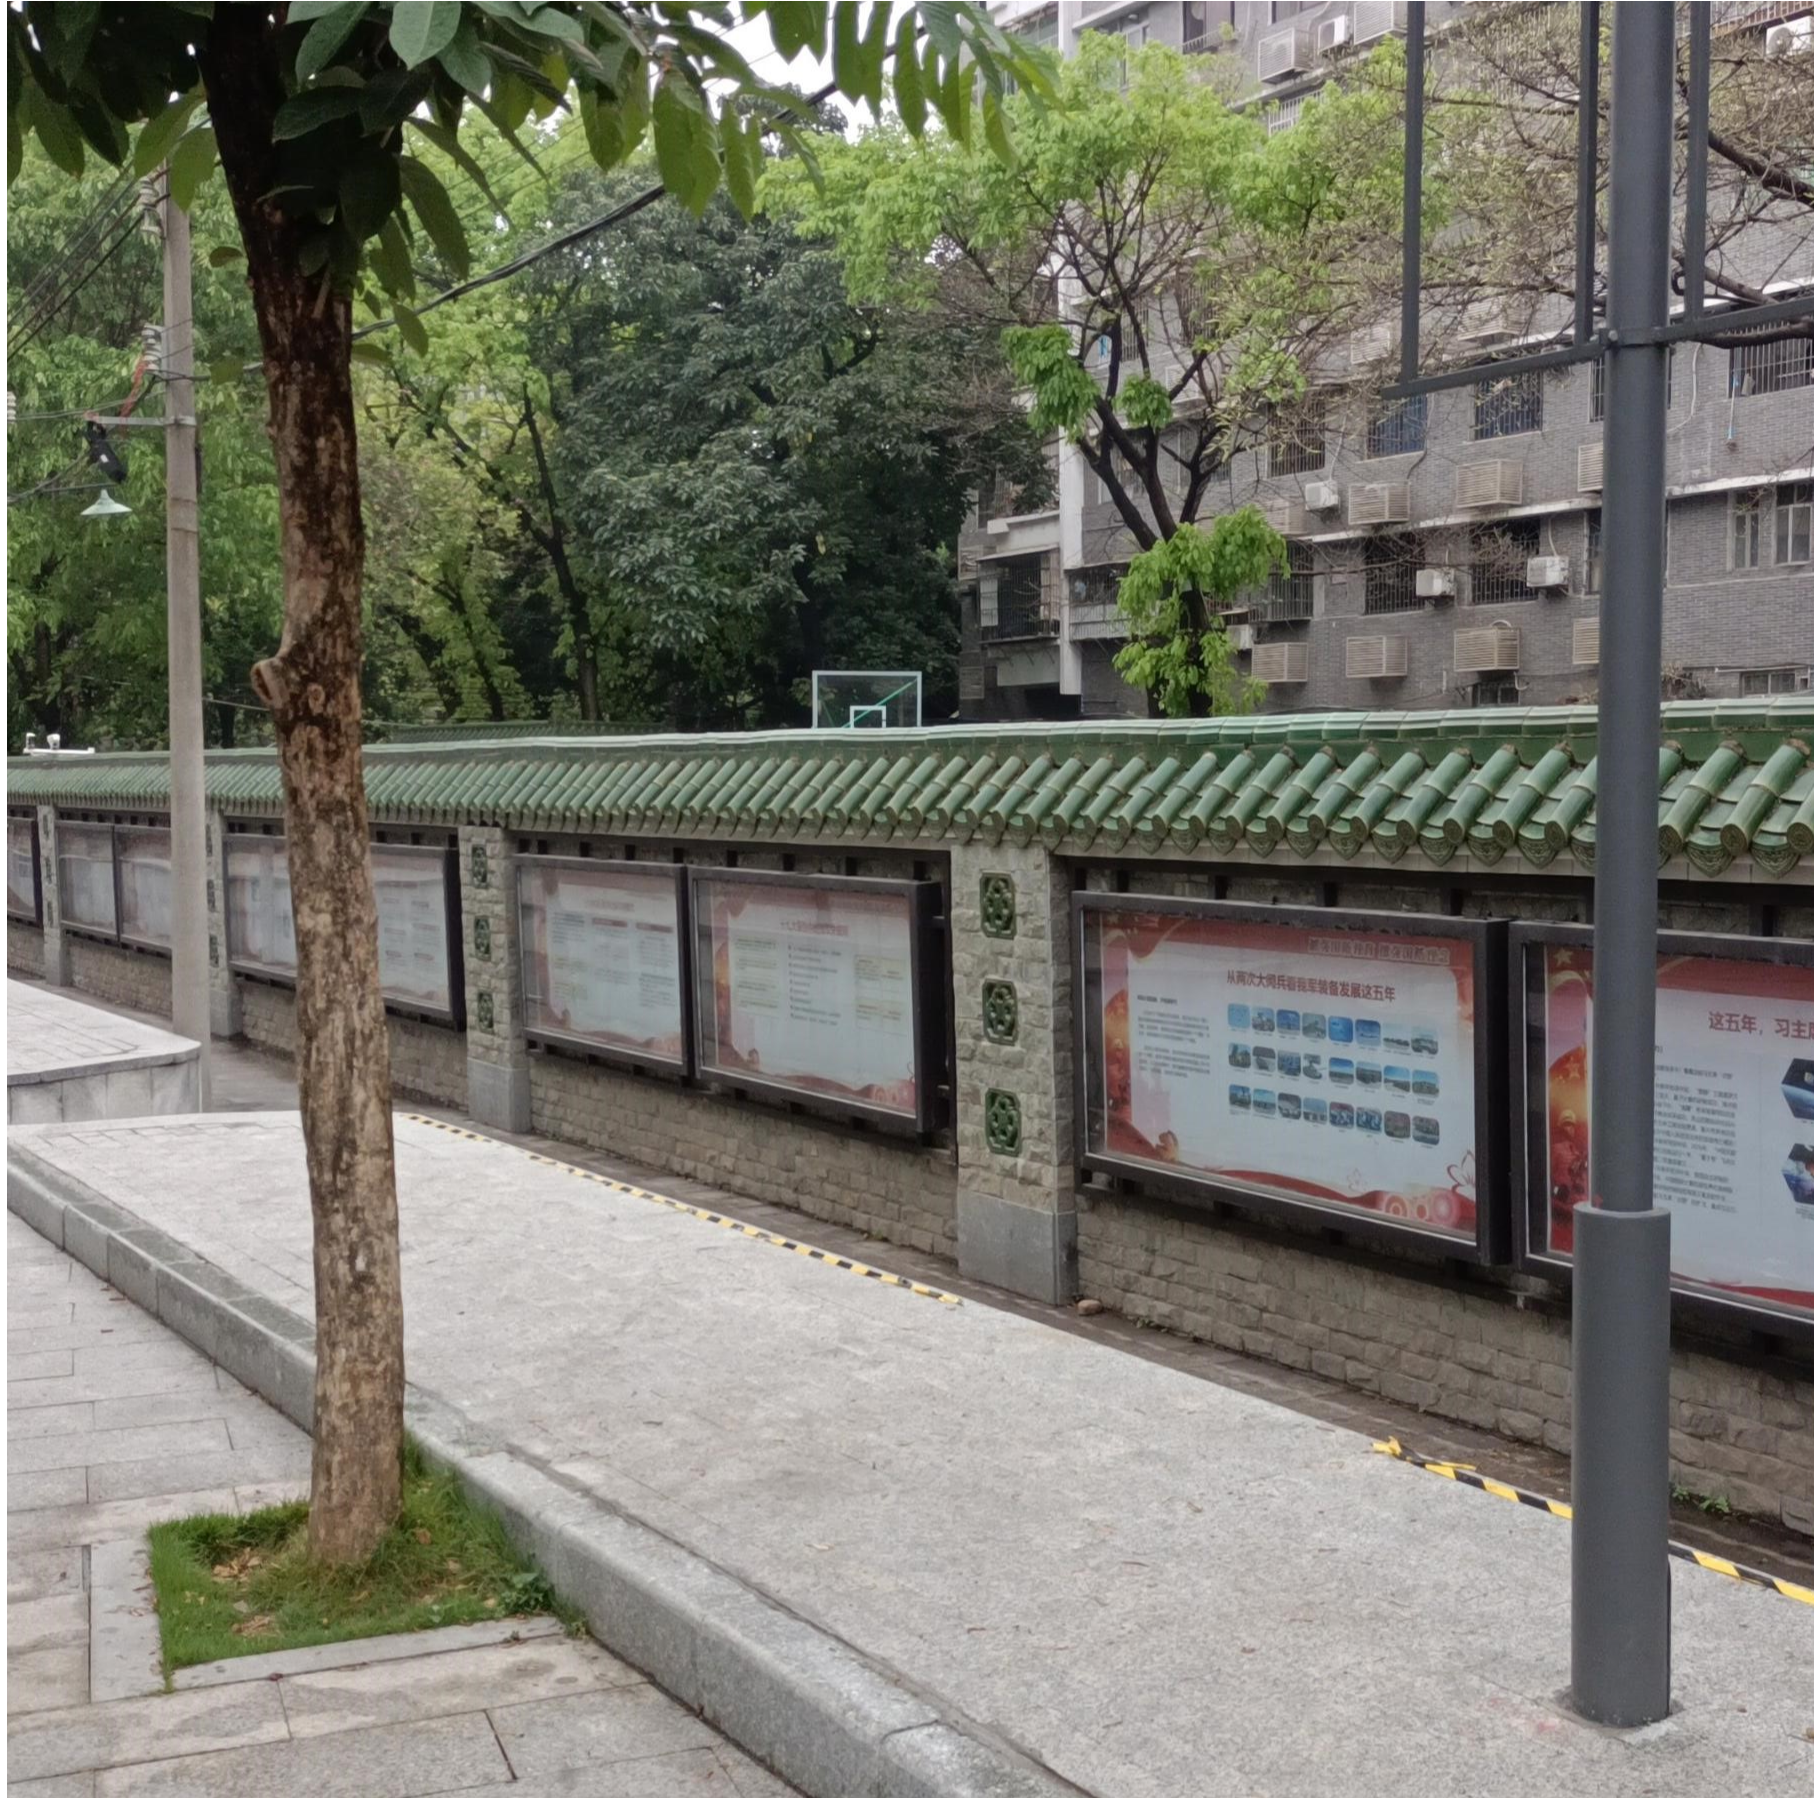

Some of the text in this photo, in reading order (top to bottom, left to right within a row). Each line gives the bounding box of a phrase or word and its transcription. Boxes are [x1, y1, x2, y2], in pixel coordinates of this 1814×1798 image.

[1709, 1011, 1814, 1040] 这五年，习主
